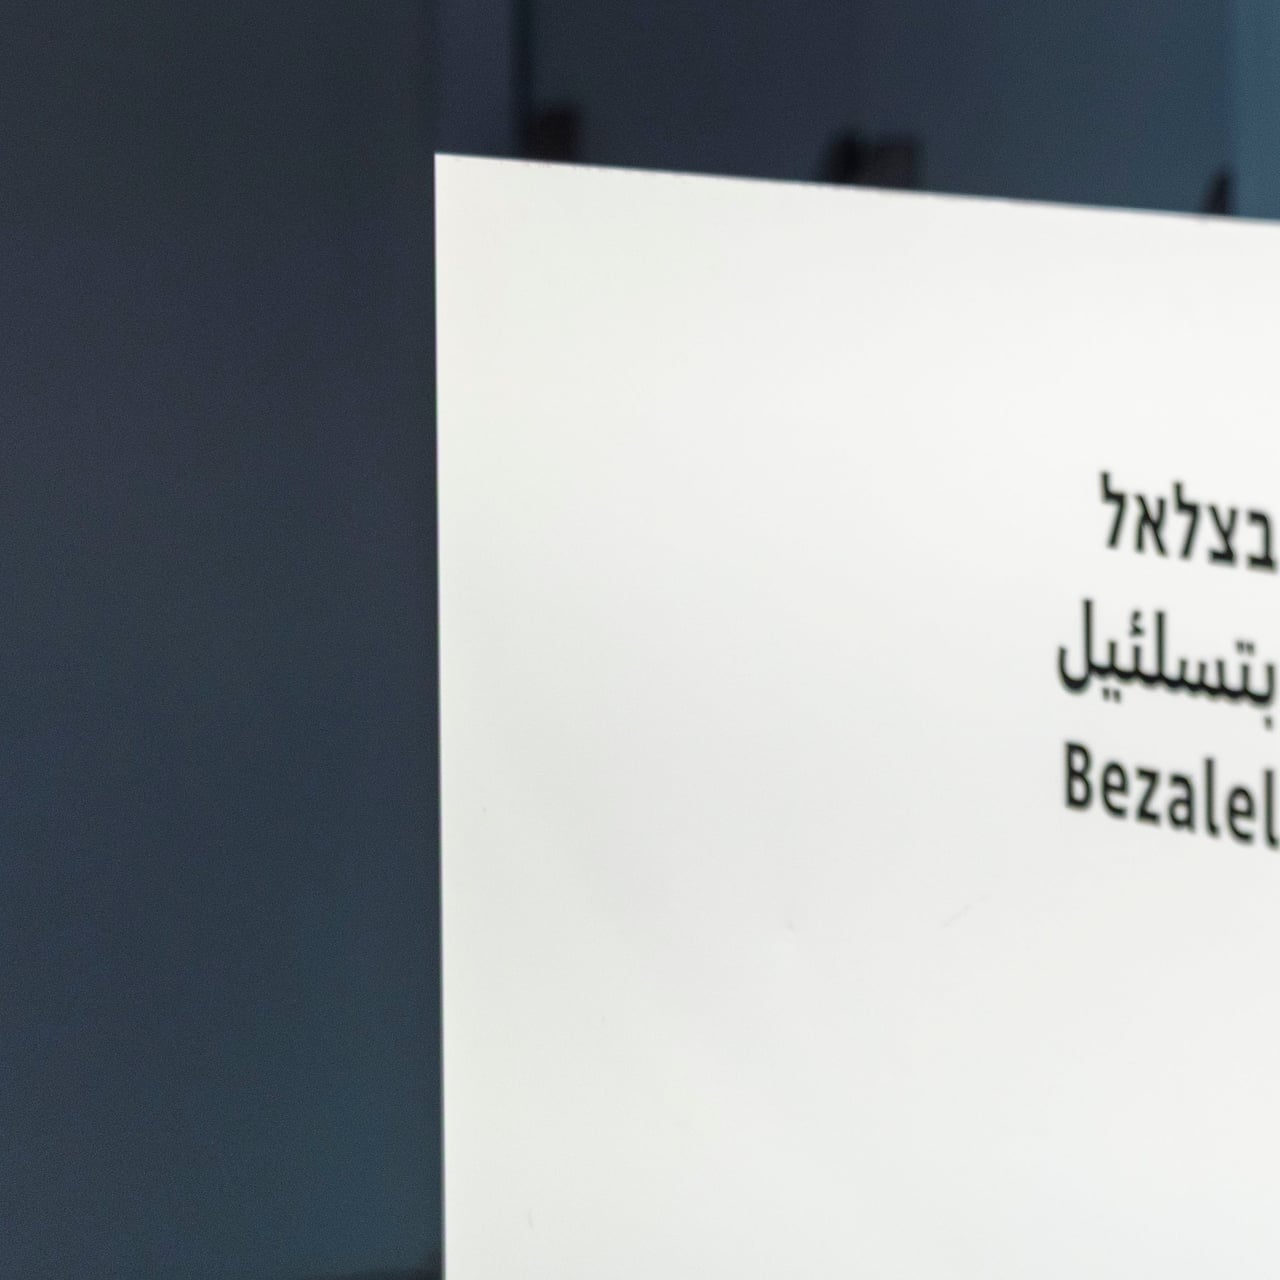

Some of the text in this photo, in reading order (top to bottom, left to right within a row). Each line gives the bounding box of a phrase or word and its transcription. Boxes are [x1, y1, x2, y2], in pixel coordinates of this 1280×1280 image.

[1099, 470, 1279, 575] בצלאל
[1056, 597, 1276, 730] بتسلئيل
[1063, 739, 1280, 851] Bezalel
